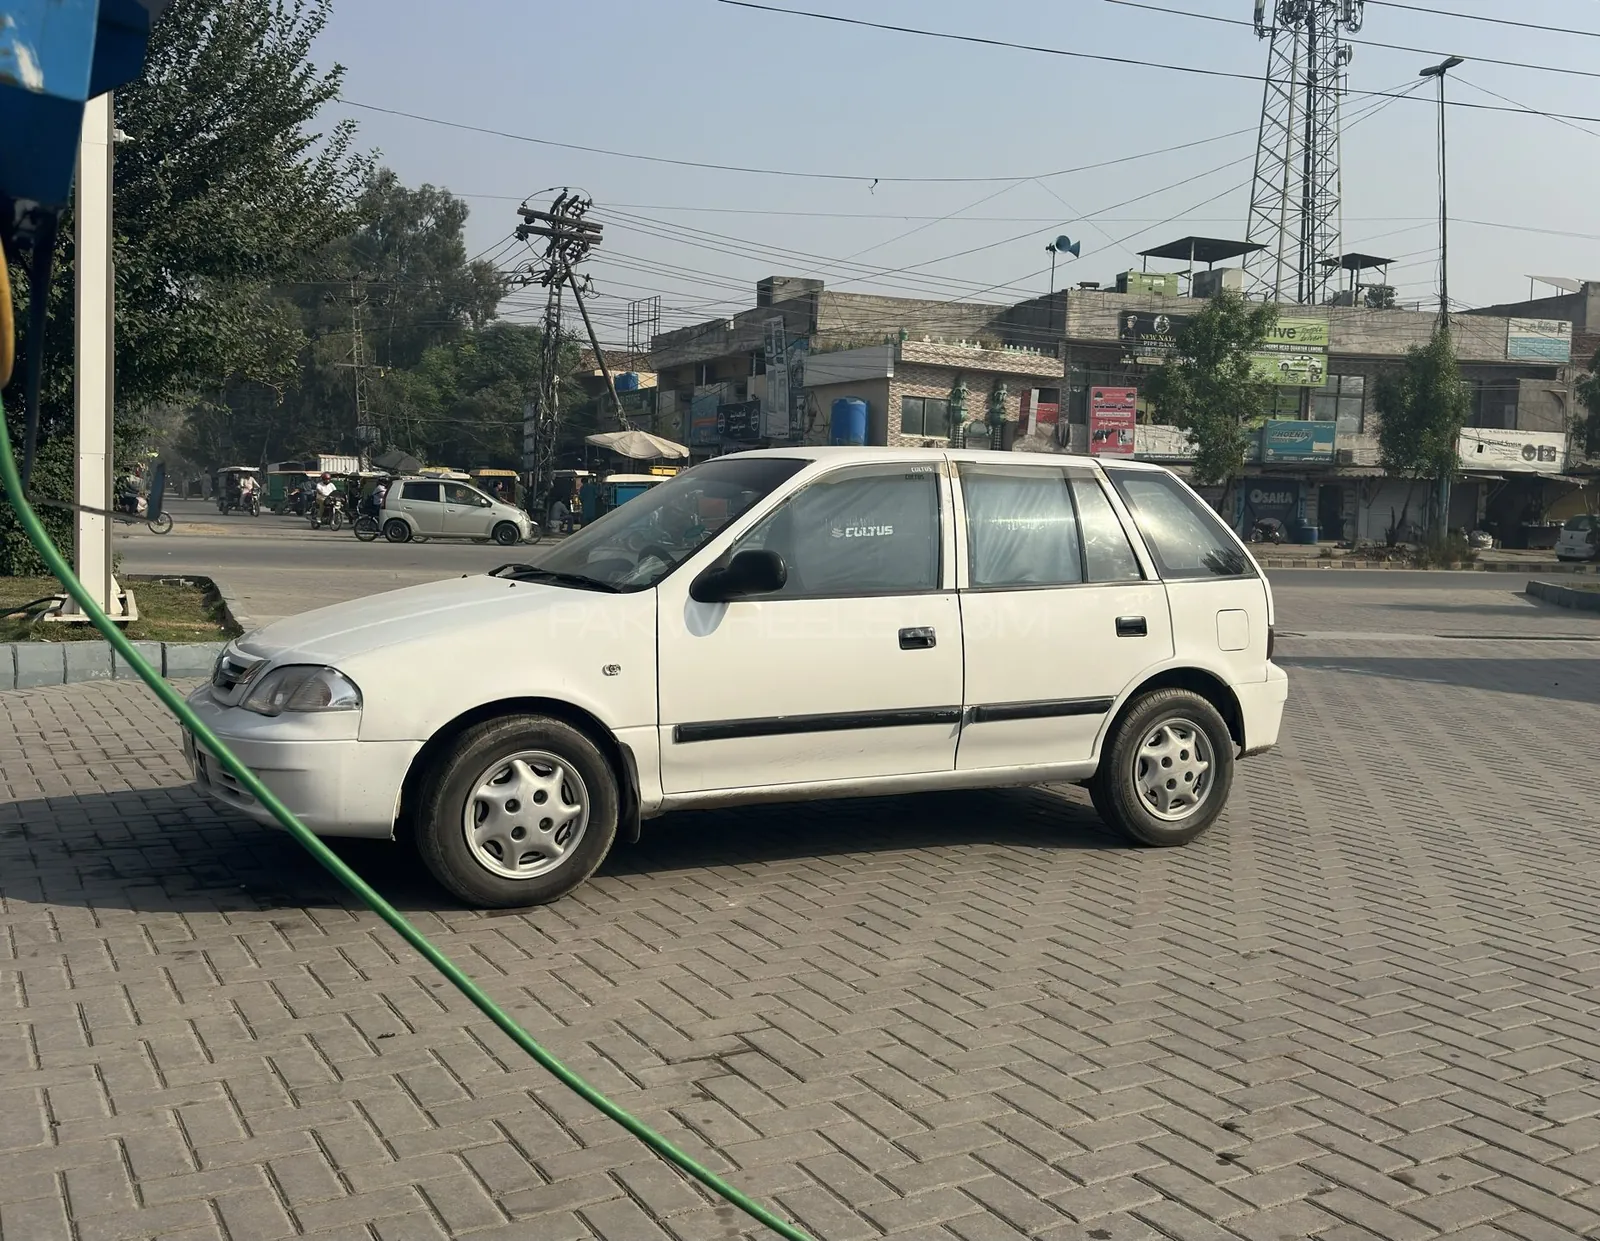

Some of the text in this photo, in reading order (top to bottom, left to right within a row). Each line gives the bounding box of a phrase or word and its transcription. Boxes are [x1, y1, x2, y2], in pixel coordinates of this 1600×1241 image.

[1266, 327, 1297, 338] rive
[1271, 429, 1311, 438] PHOENIX
[1249, 489, 1293, 504] OSAKA
[845, 525, 894, 537] CULTUS
